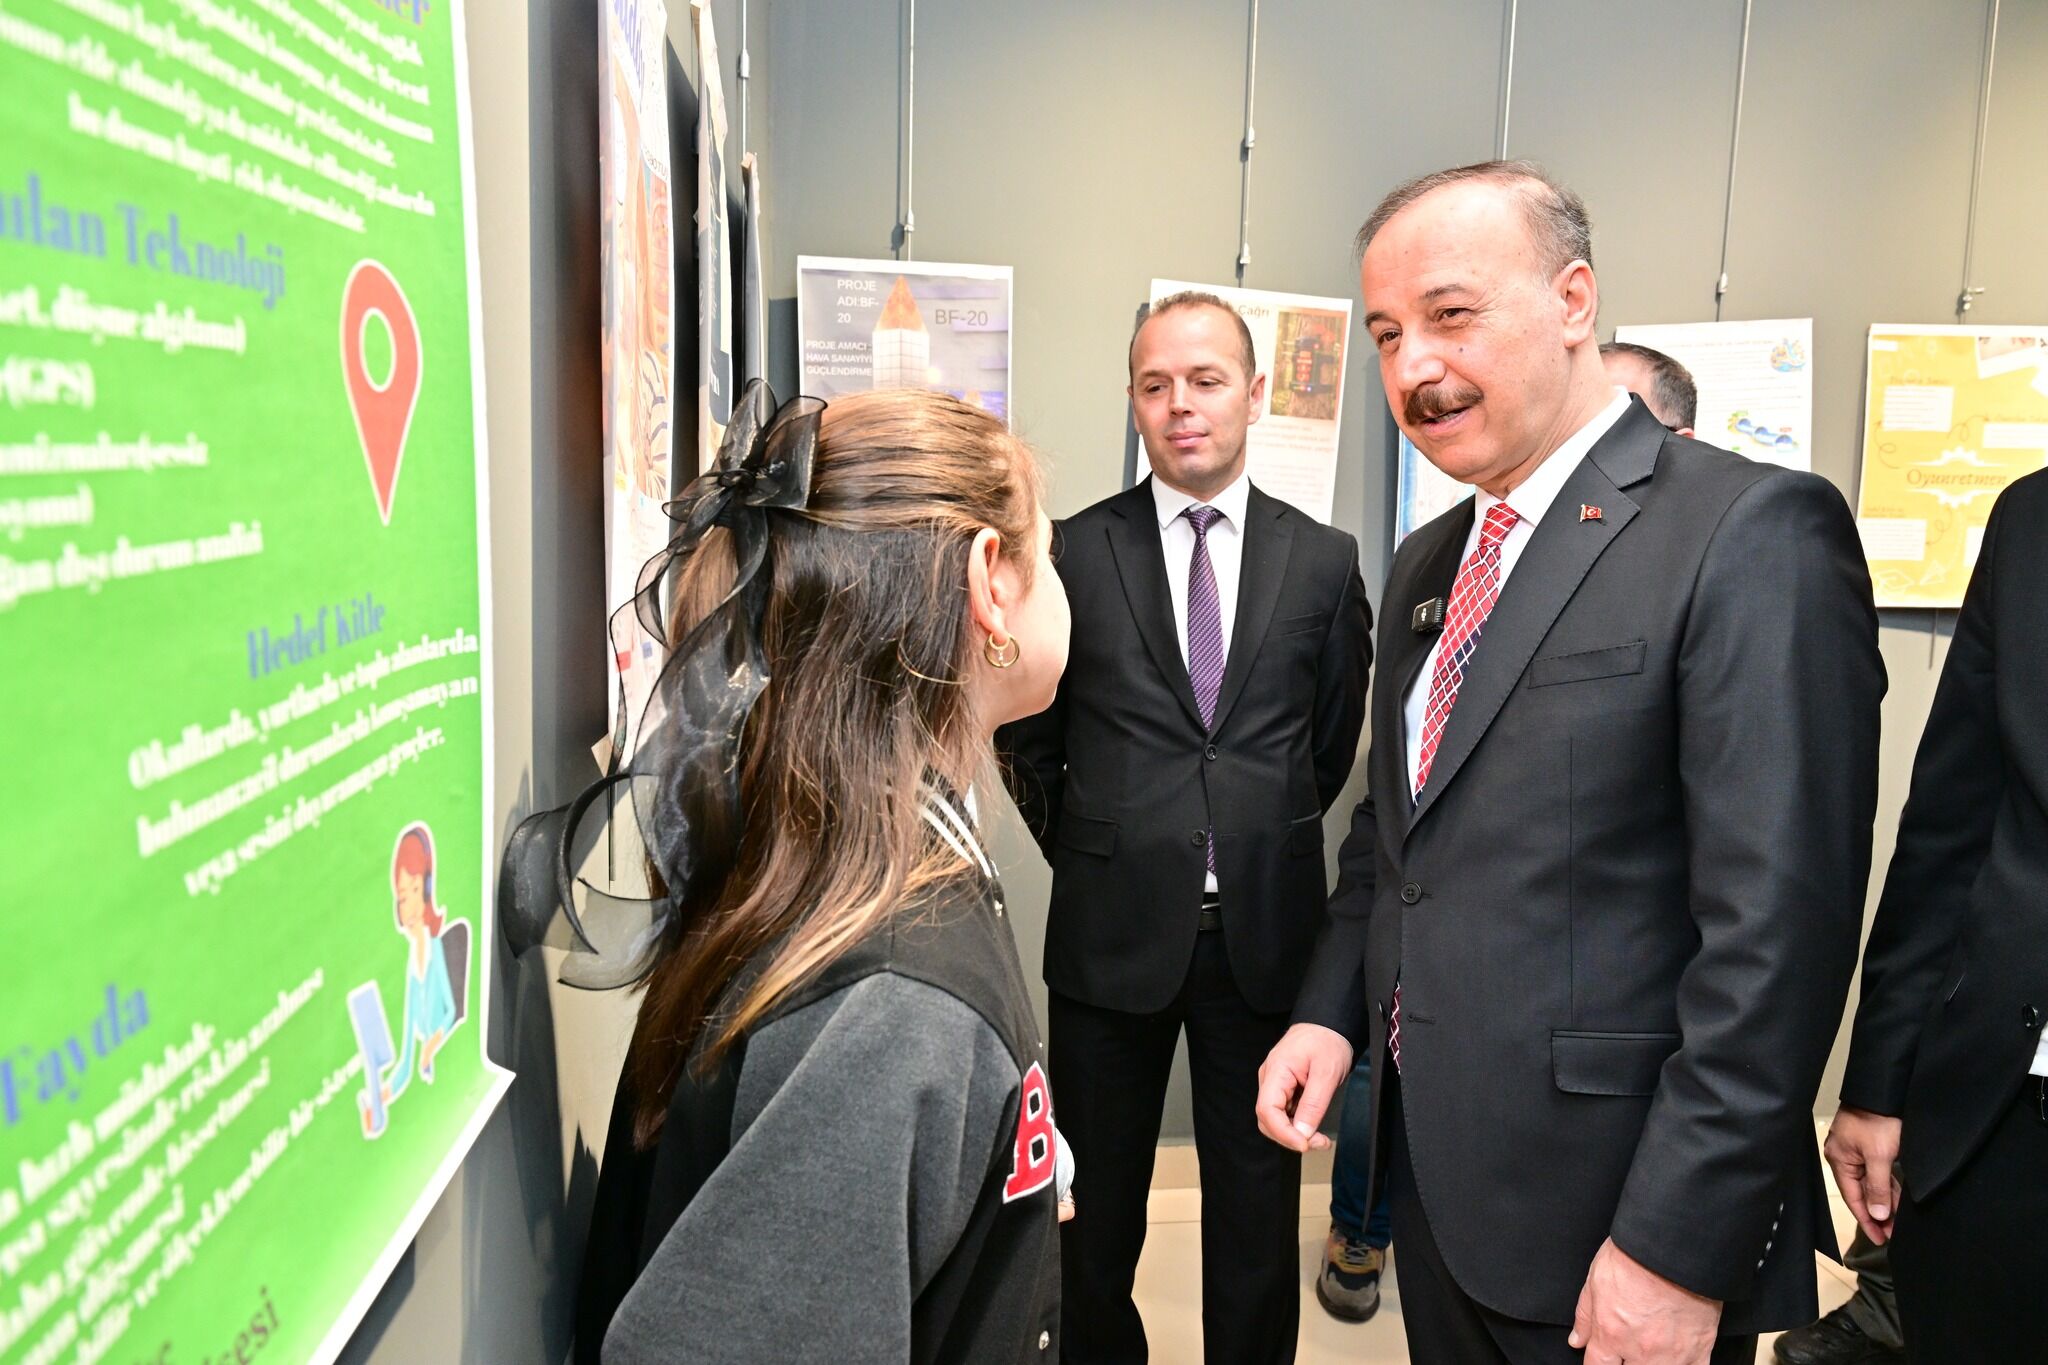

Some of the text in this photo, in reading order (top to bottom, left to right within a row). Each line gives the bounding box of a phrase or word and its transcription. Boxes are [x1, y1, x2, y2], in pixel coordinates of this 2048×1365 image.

[115, 200, 286, 312] Teknoloji
[837, 279, 877, 292] PROJE
[837, 312, 852, 324] 20
[935, 309, 988, 326] BF-20
[806, 340, 837, 350] PROJE
[806, 352, 830, 362] HAVA
[246, 591, 386, 681] Hedef Kitle
[0, 983, 150, 1128] Fayda
[1003, 1061, 1057, 1204] B
